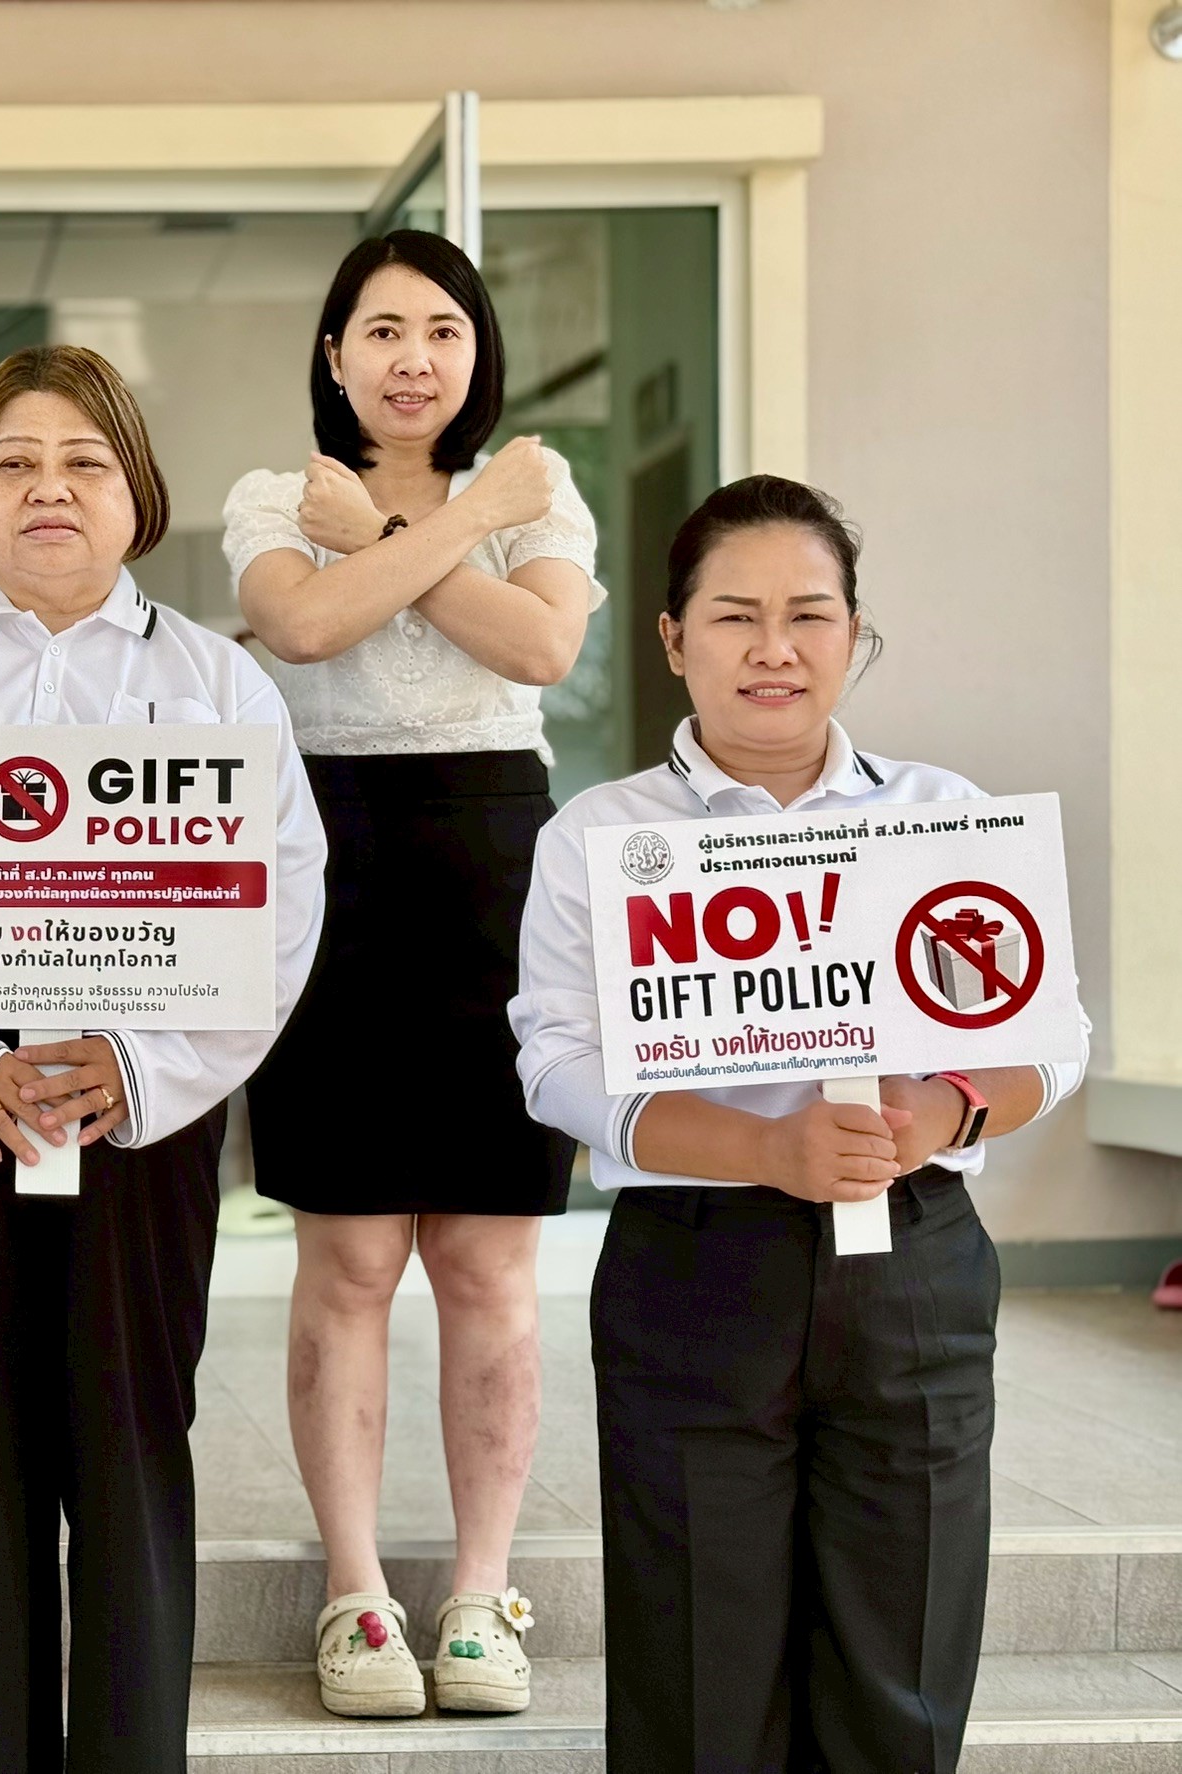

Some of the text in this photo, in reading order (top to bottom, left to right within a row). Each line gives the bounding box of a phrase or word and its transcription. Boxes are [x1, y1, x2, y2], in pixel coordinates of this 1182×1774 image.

[86, 757, 246, 805] GIFT
[85, 815, 246, 846] POLICY
[697, 813, 1026, 854] ผู้บริหารและเจ้าหน้าที่ ส.ป.ก.แพร่ ทุกคน
[24, 866, 106, 882] ส.ป.ก.แพร่
[110, 869, 155, 885] ทุกคน
[698, 846, 859, 874] ประกาศเจตนารมณ์
[10, 918, 177, 947] งดให้ของขวัญ
[87, 983, 143, 998] จริยธรรม
[146, 983, 221, 998] ความโปร่งใส
[628, 959, 877, 1023] GIFT POLICY
[634, 1021, 876, 1063] งดรับ งดให้ของขวัญ
